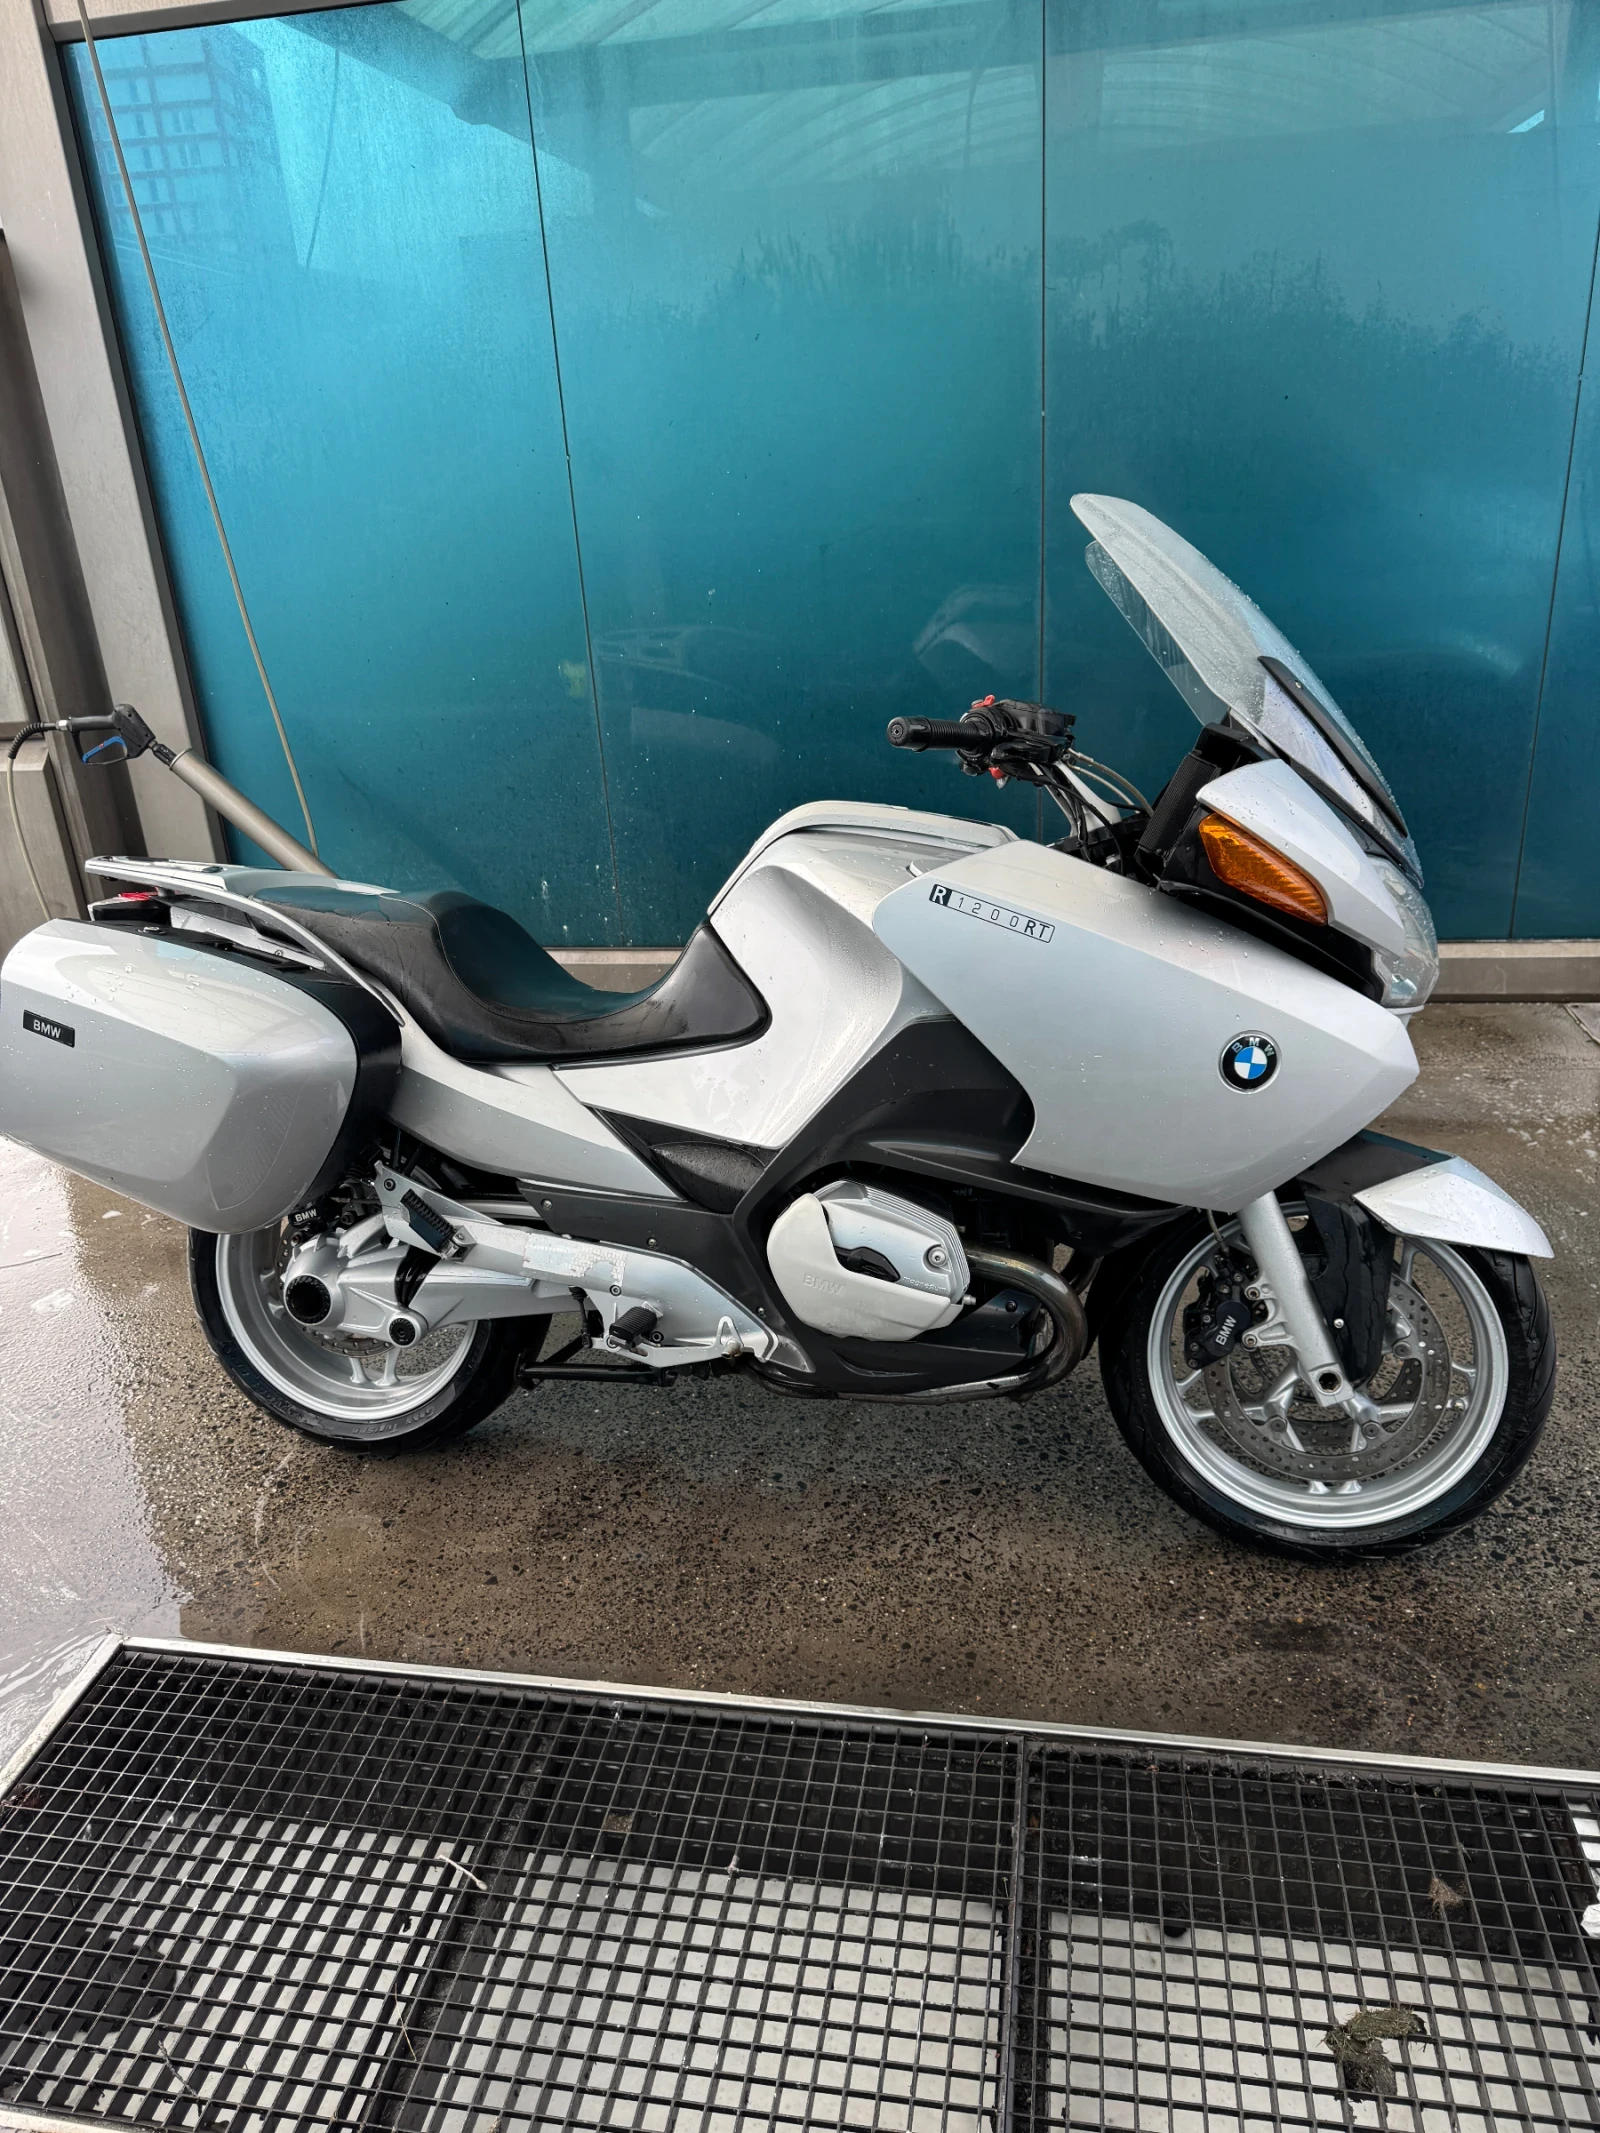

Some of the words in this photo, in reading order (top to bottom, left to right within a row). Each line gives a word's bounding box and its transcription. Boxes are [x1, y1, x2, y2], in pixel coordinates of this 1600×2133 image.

[33, 1019, 61, 1039] BMW
[1231, 1036, 1275, 1057] BMW
[294, 1208, 317, 1222] BMW
[803, 1273, 846, 1296] BMW
[1215, 1315, 1237, 1345] BMW
